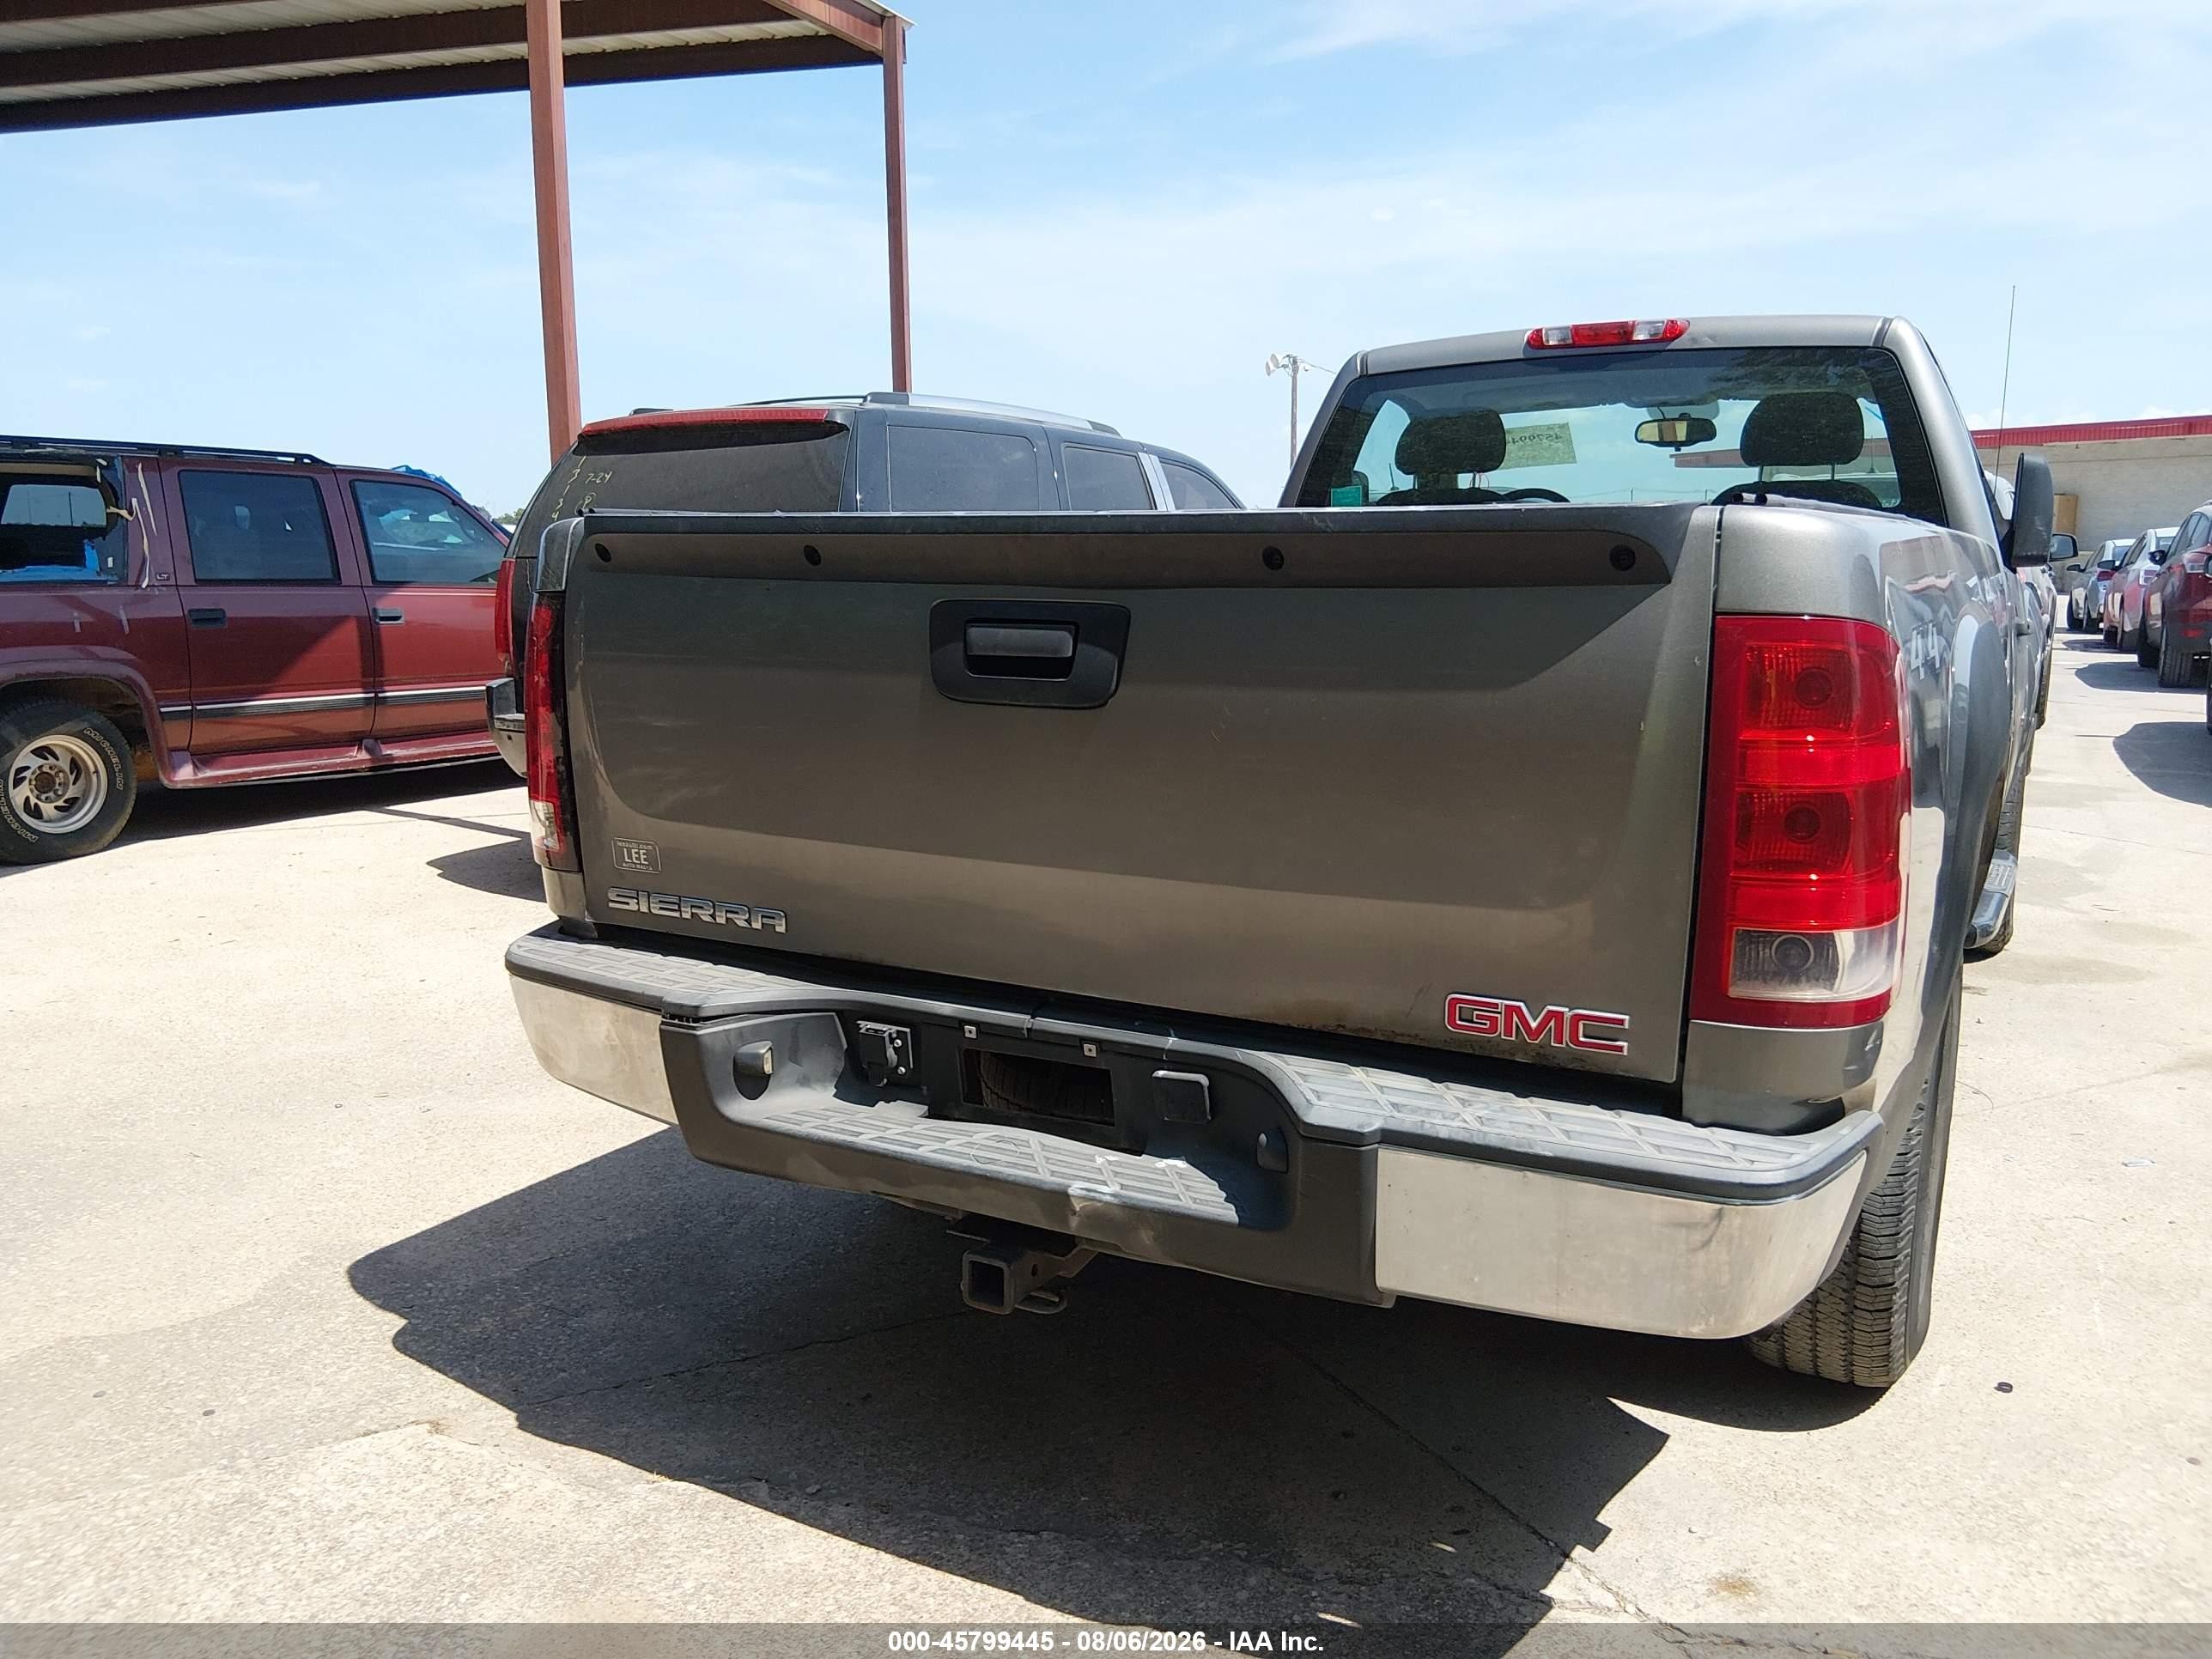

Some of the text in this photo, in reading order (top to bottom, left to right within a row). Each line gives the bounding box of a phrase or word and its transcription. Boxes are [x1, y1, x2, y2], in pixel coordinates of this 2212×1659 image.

[623, 848, 649, 865] LEE
[607, 887, 787, 933] SIERRA
[1445, 994, 1630, 1056] GMC
